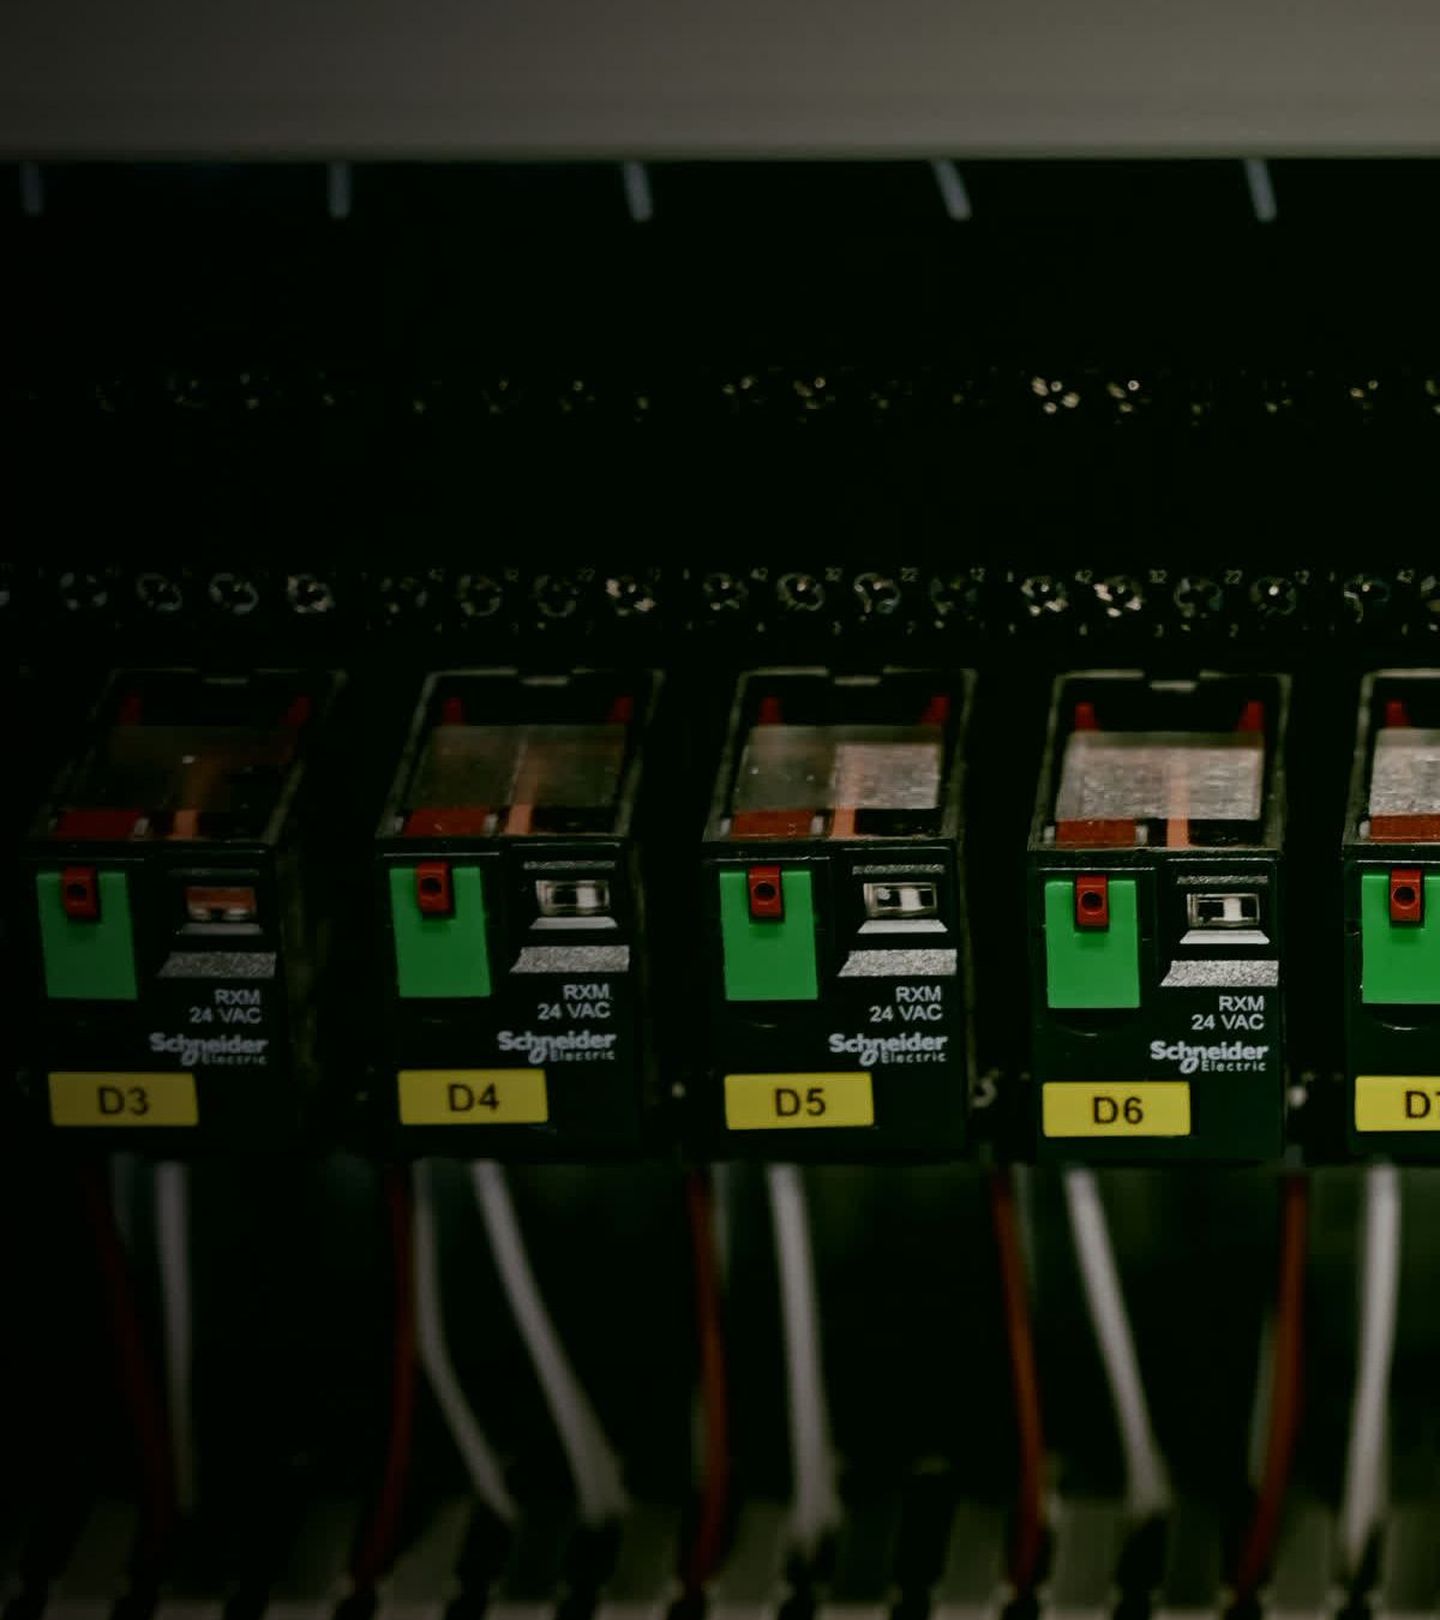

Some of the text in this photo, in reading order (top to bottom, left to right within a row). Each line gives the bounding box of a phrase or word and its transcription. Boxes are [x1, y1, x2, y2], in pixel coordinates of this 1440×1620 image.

[214, 988, 261, 1006] RXM
[562, 982, 610, 1001] RXM
[895, 984, 942, 1003] RXM
[537, 1001, 611, 1021] 24 VAC
[1218, 994, 1265, 1012] RXM
[189, 1006, 262, 1025] 24 VAC
[869, 1003, 944, 1023] 24 VAC
[1191, 1013, 1265, 1031] 24 VAC
[148, 1032, 270, 1067] Schneider
[496, 1029, 617, 1065] Schneider
[549, 1049, 616, 1063] Electric
[828, 1031, 949, 1067] Schneider
[200, 1052, 268, 1066] Electric
[880, 1051, 947, 1065] Electric
[1149, 1040, 1270, 1075] Schneider
[1200, 1060, 1267, 1073] Electric
[97, 1085, 150, 1116] D3
[447, 1083, 500, 1113] D4
[774, 1087, 827, 1117] D5
[1092, 1095, 1144, 1125] D6
